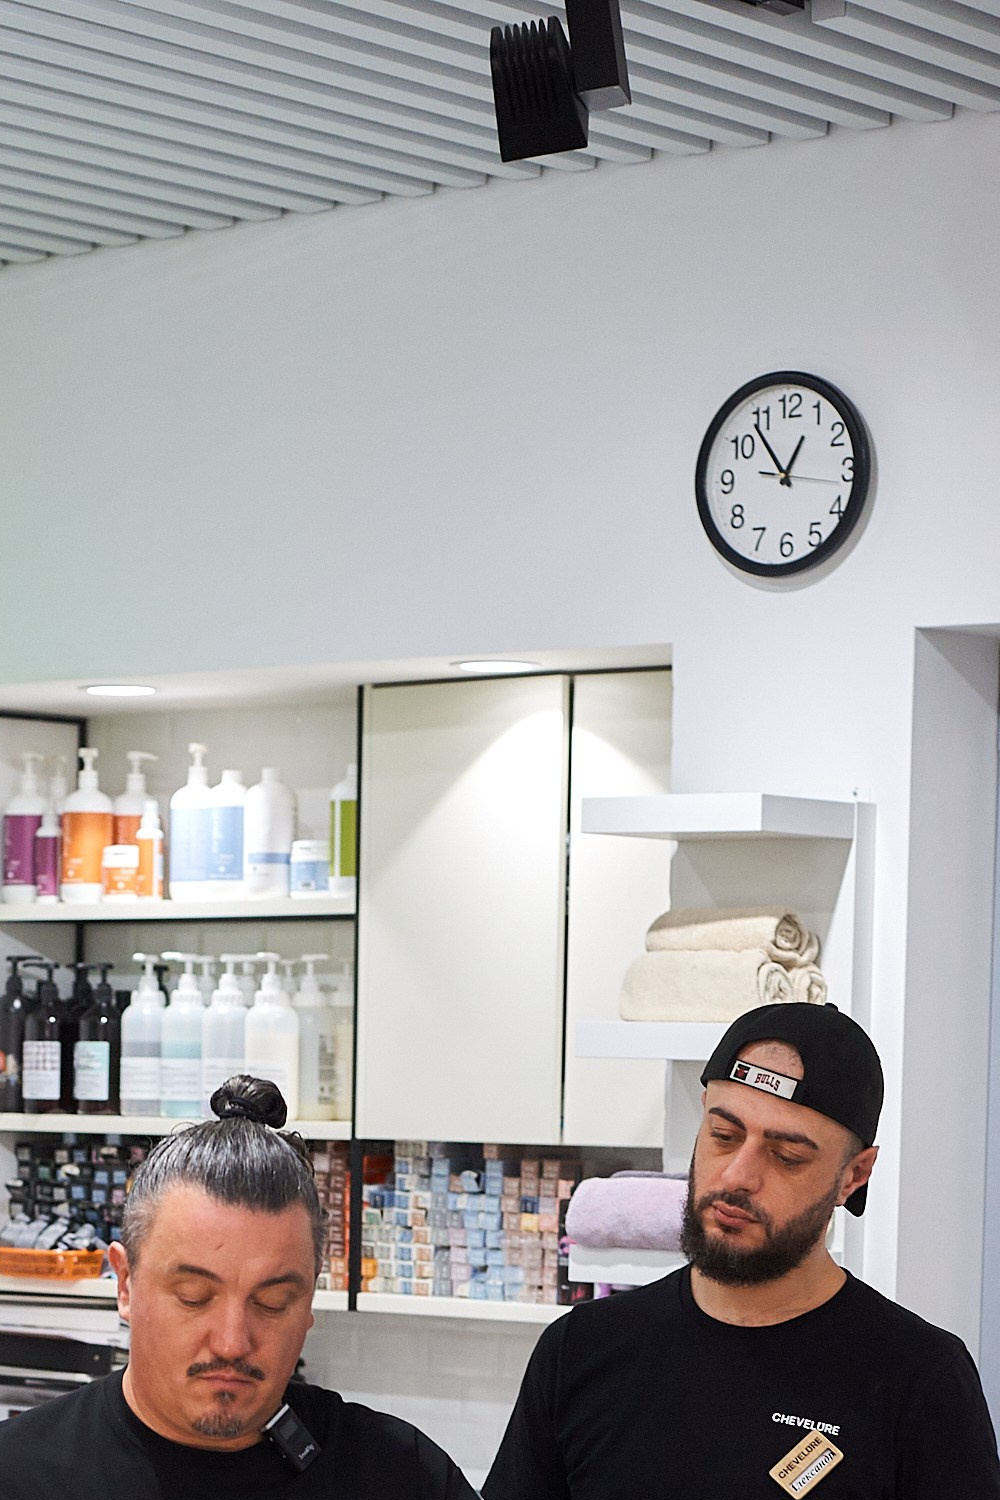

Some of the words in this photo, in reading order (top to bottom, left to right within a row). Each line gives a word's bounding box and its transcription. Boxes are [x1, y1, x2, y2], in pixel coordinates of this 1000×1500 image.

[752, 406, 771, 430] 11
[778, 393, 803, 419] 12
[812, 400, 821, 425] 1
[831, 421, 845, 447] 2
[731, 434, 755, 460] 10
[721, 469, 735, 494] 9
[841, 456, 854, 482] 3
[730, 504, 745, 529] 8
[829, 494, 845, 521] 4
[752, 527, 767, 552] 7
[780, 532, 794, 558] 6
[808, 522, 822, 547] 5
[754, 1073, 781, 1092] BULLS
[771, 1412, 841, 1436] CHEVELURE
